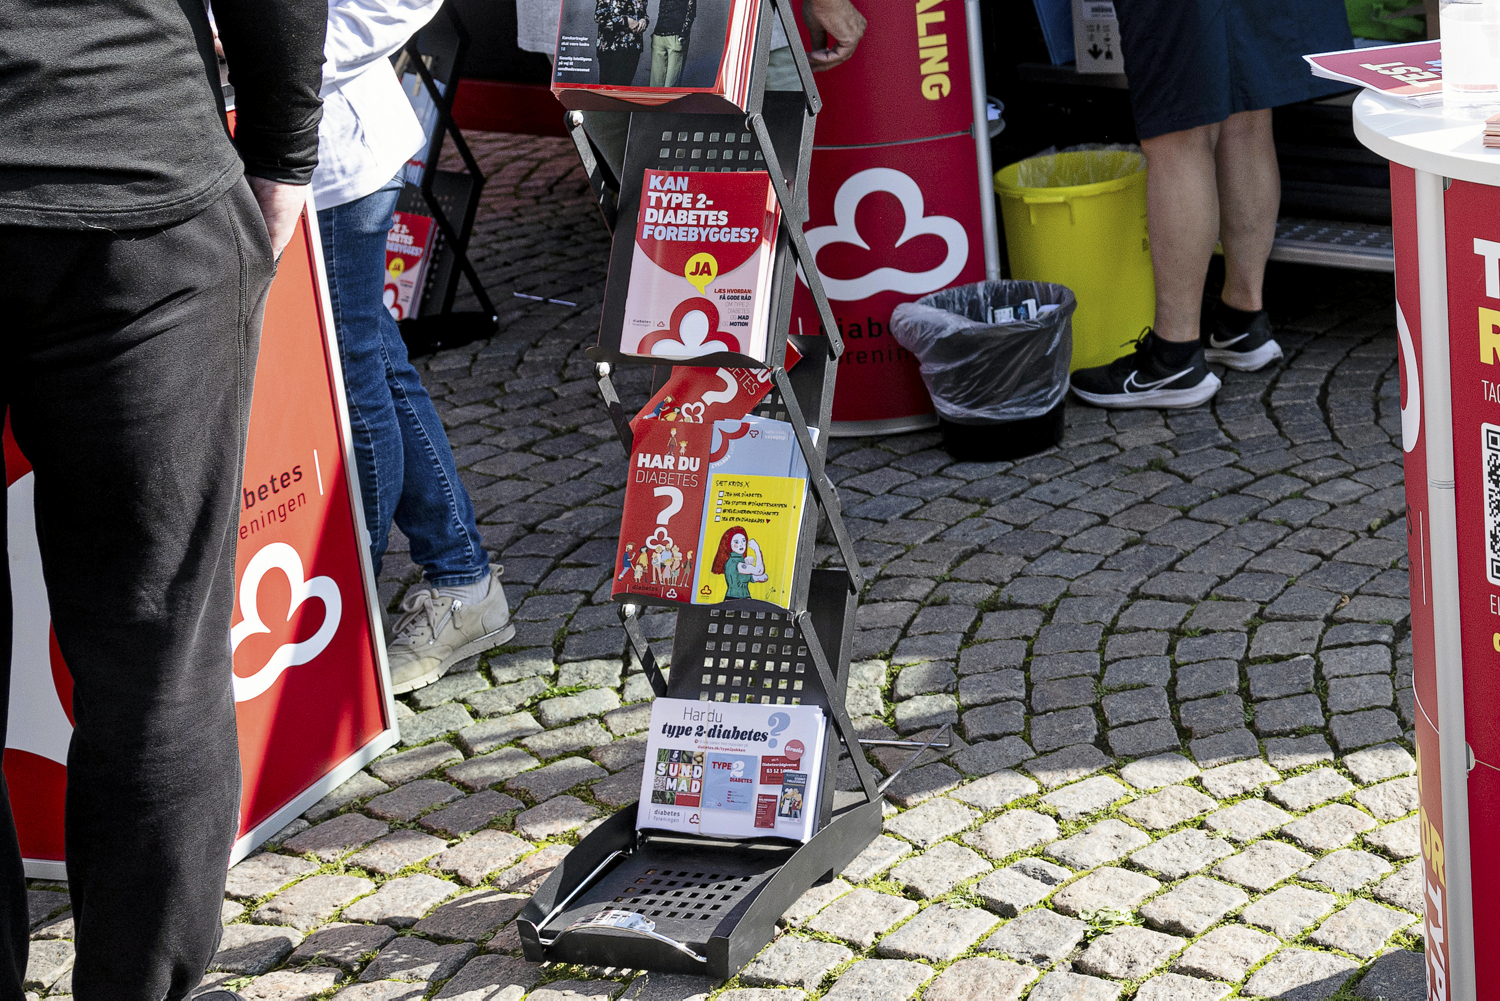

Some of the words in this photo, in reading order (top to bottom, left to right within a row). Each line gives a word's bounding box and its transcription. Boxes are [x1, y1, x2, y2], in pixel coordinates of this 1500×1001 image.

[649, 175, 689, 191] KAN
[647, 192, 693, 208] TYPE
[695, 193, 714, 208] 2-
[644, 208, 729, 226] DIABETES
[642, 225, 759, 243] FOREBYGGES?
[689, 261, 712, 276] JA
[637, 453, 676, 470] HAR
[677, 456, 701, 472] DU
[635, 470, 699, 487] DIABETES
[653, 486, 685, 525] ?
[239, 492, 307, 540] eningen
[683, 706, 706, 722] Har
[708, 710, 723, 723] du
[661, 722, 693, 738] type
[694, 725, 769, 743] 2-diabetes
[767, 712, 791, 748] ?
[786, 745, 803, 754] Gratis
[656, 762, 703, 779] SUND
[712, 761, 732, 771] TYPE
[730, 760, 746, 778] 2
[665, 778, 701, 793] MAD
[654, 809, 681, 817] diabetes
